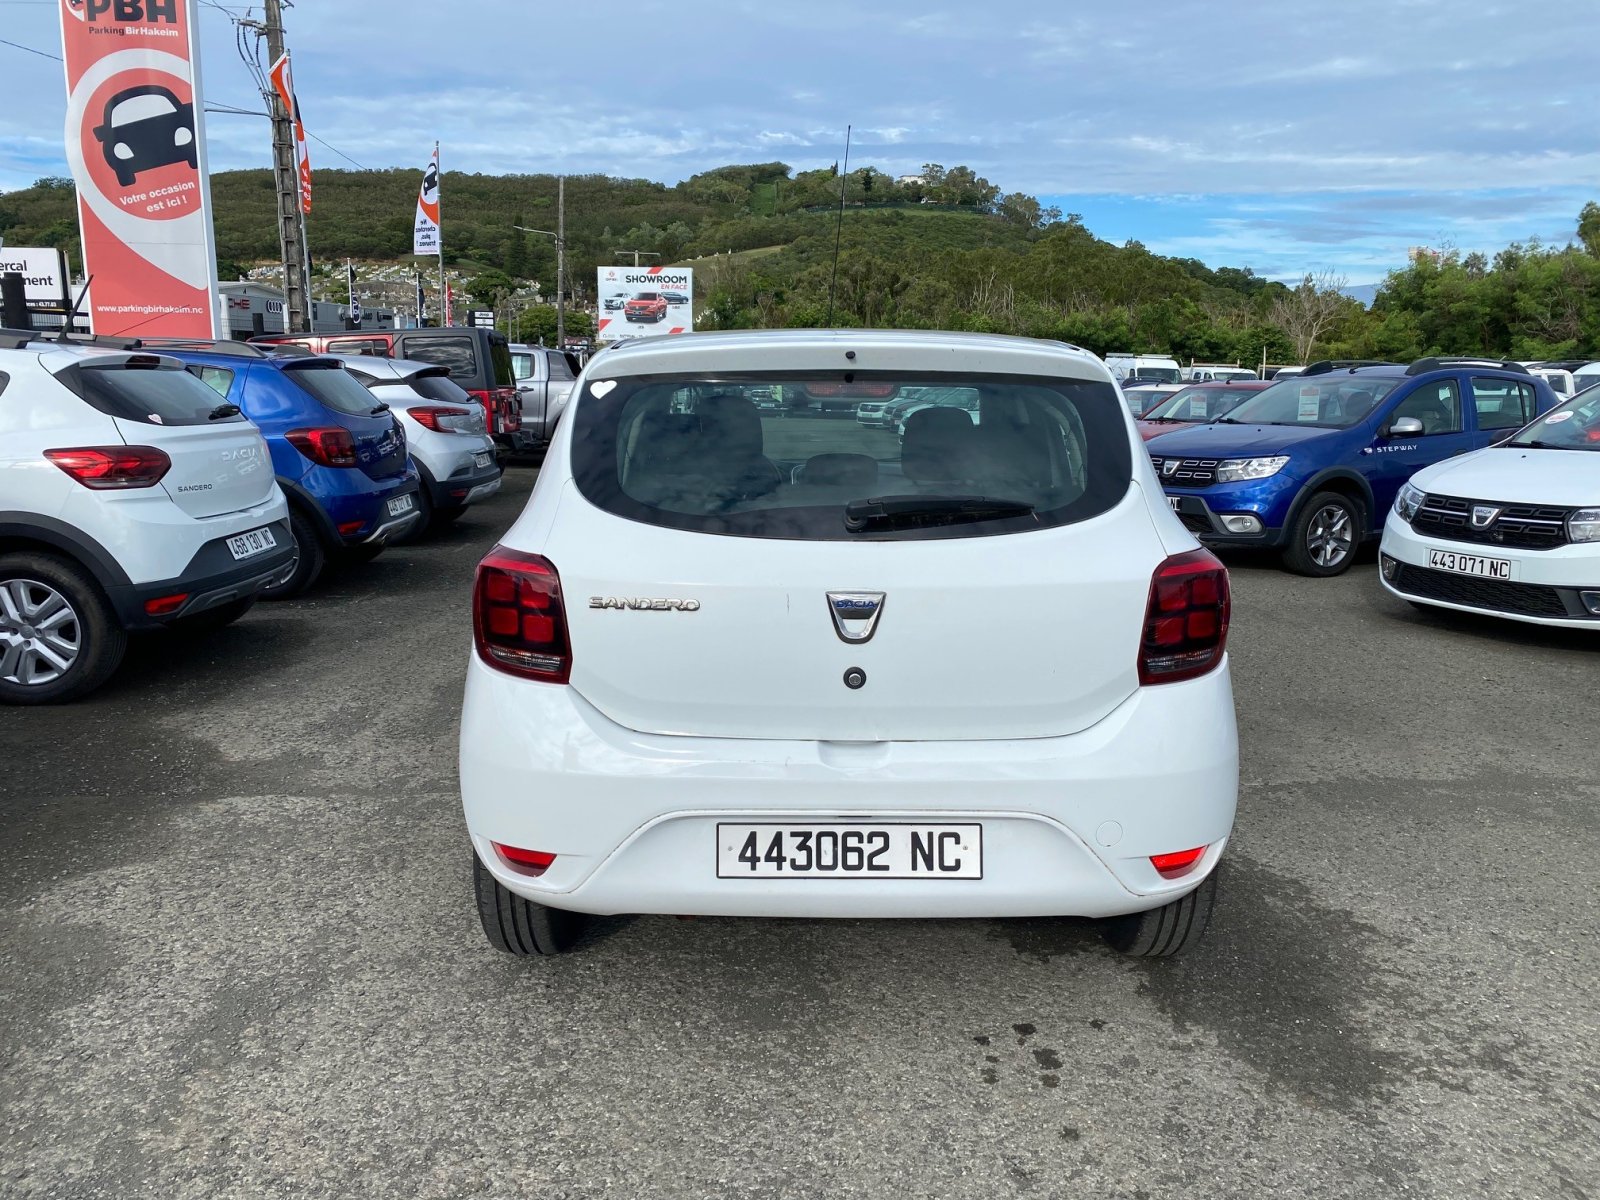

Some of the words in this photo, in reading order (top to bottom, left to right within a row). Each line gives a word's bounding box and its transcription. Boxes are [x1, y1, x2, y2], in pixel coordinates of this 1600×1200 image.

[86, 0, 177, 23] PBH
[119, 193, 147, 206] Votre
[149, 181, 195, 198] occasion
[146, 200, 165, 213] est
[625, 275, 688, 284] SHOWROOM
[1376, 445, 1418, 453] STEPWAY
[178, 484, 213, 493] SANDERO
[230, 538, 249, 556] 468
[246, 533, 263, 551] 130
[260, 529, 274, 546] NC
[1431, 552, 1456, 570] 443
[1459, 556, 1485, 575] 071
[1489, 560, 1509, 578] NC
[589, 596, 701, 612] SANDERO
[836, 600, 876, 608] DACIA
[738, 831, 890, 871] 443062
[911, 831, 961, 872] NC
